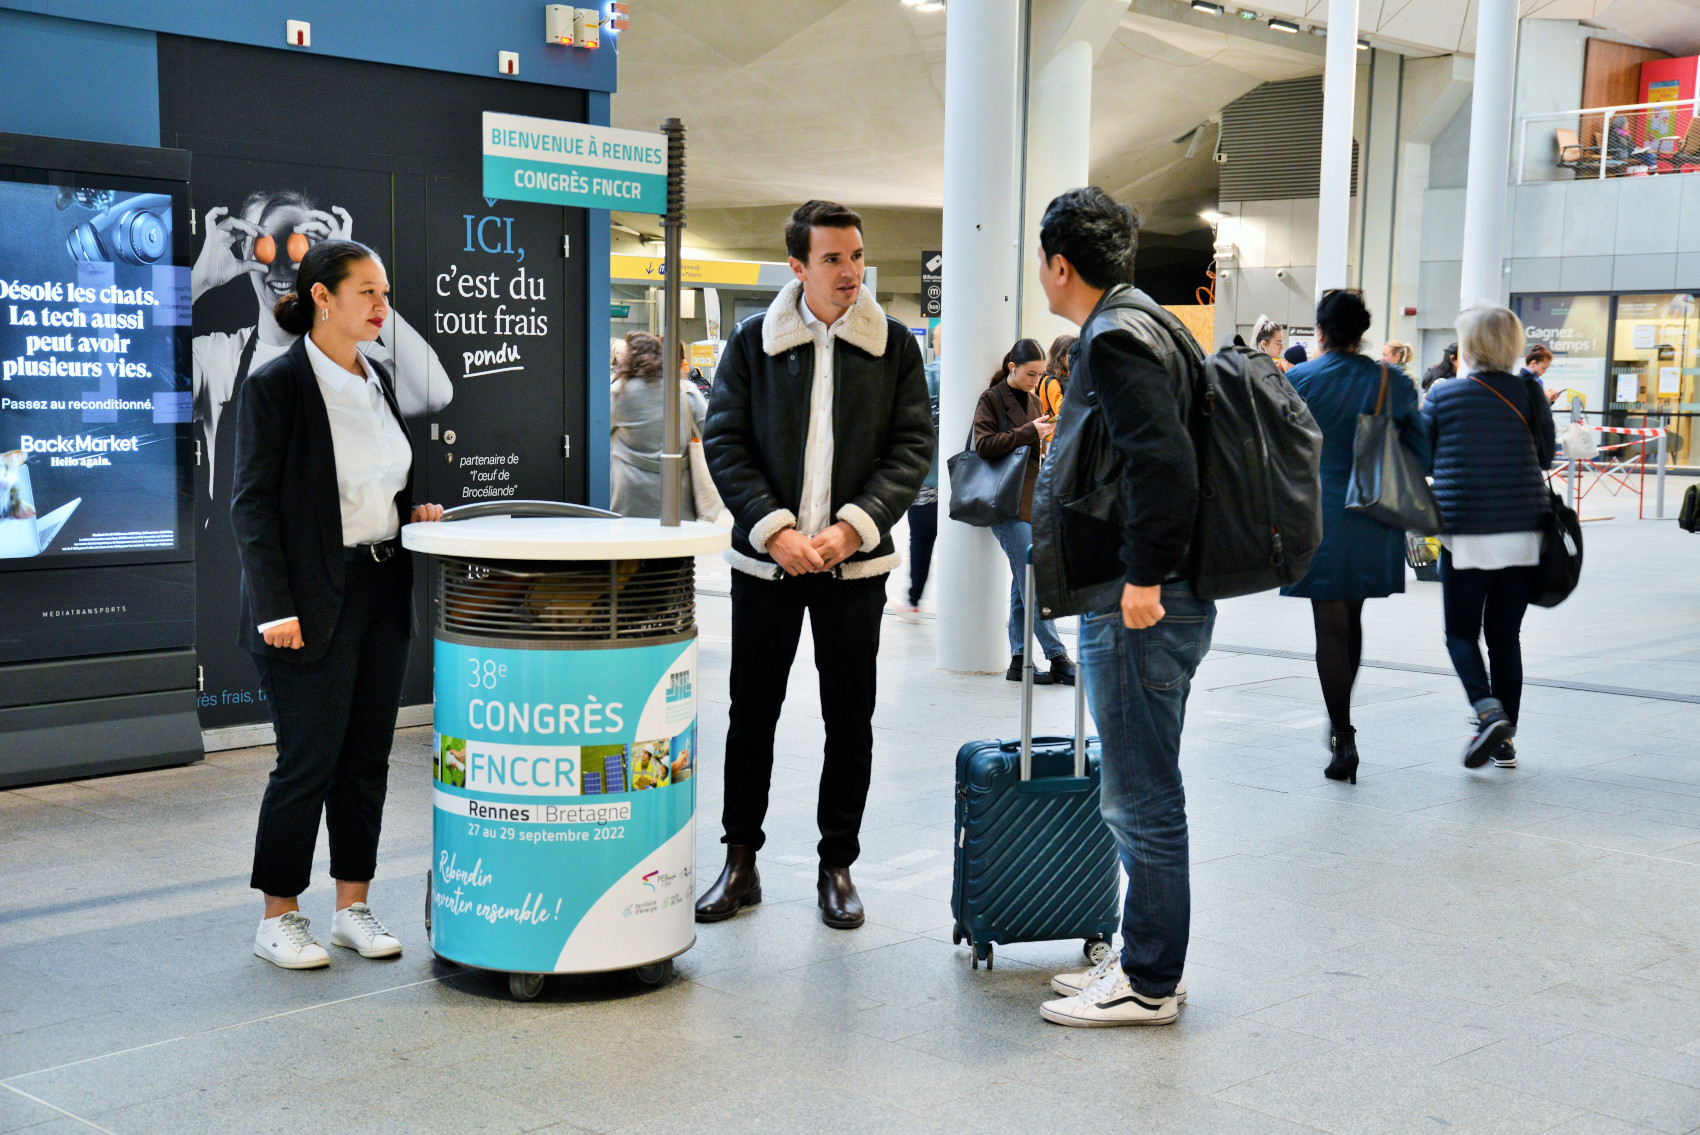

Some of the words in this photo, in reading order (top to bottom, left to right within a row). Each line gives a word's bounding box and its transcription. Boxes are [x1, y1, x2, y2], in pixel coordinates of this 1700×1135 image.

[491, 128, 584, 156] BIENVENUE
[588, 134, 598, 157] À
[603, 142, 662, 165] RENNES
[514, 169, 589, 194] CONGRÈS
[593, 178, 642, 200] FNCCR
[462, 214, 525, 263] ICI,
[436, 264, 500, 299] c'est
[509, 267, 546, 300] du
[67, 283, 96, 303] les
[100, 285, 160, 306] chats.
[9, 305, 37, 326] La
[41, 308, 87, 328] tech
[91, 310, 145, 329] aussi
[434, 309, 488, 335] tout
[494, 305, 548, 336] frais
[26, 333, 74, 356] peut
[78, 334, 131, 353] avoir
[1525, 325, 1574, 342] Gagnez
[1549, 339, 1590, 353] temps
[1592, 338, 1597, 350] !
[2, 356, 102, 381] plusieurs
[106, 358, 153, 378] vies.
[462, 342, 521, 374] pondu
[1, 398, 48, 410] Passez
[50, 400, 66, 410] au
[68, 398, 155, 410] reconditionné.
[50, 457, 79, 467] Hello
[80, 457, 112, 469] again.
[459, 454, 506, 469] partenaire
[507, 452, 519, 465] de
[498, 468, 510, 481] de
[42, 605, 127, 618] MEDIATRANSPORTS
[221, 688, 254, 705] frais,
[468, 694, 624, 735] CONGRÈS
[471, 752, 575, 788] FNCCR
[469, 800, 530, 822] Rennes
[545, 805, 629, 826] Bretagne
[468, 822, 480, 836] 27
[482, 826, 497, 839] au
[500, 827, 515, 840] 29
[519, 829, 590, 845] septembre
[593, 826, 625, 841] 2022
[439, 849, 493, 887] Rebondir
[476, 892, 551, 925] ensemble
[554, 897, 563, 921] !
